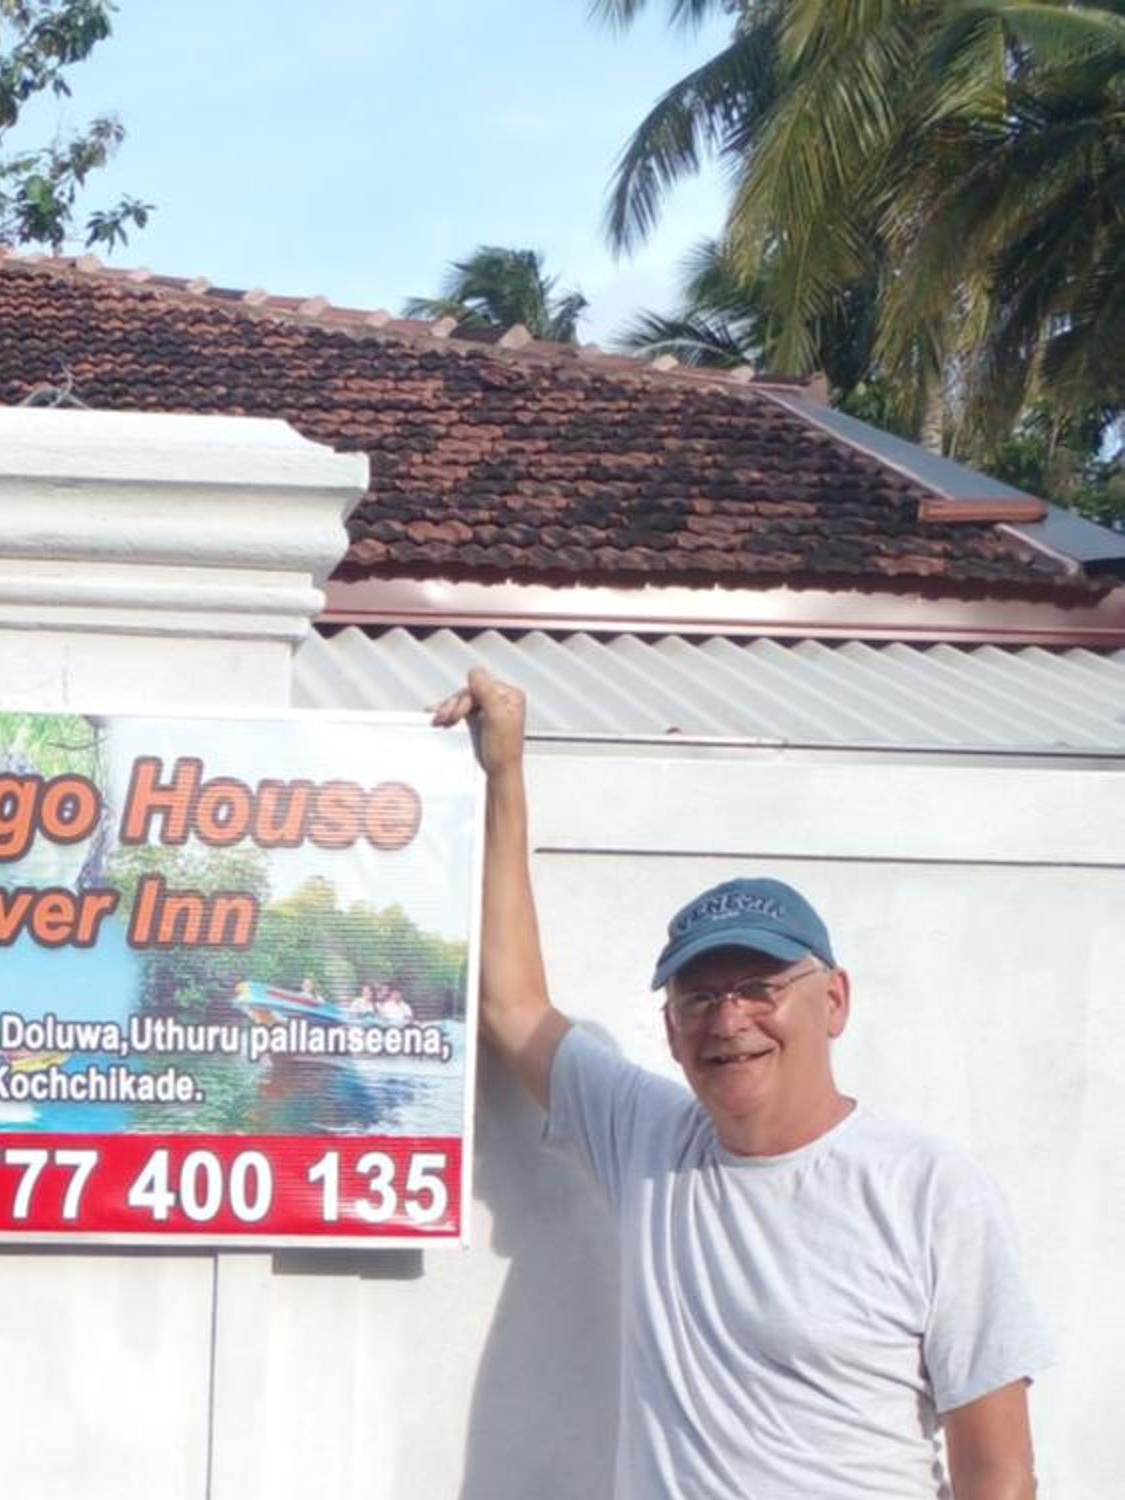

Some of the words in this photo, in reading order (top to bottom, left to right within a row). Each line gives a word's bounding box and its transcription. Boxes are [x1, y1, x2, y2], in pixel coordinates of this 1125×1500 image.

[119, 756, 422, 850] House
[127, 873, 260, 949] Inn
[249, 1019, 453, 1060] pallanseena,
[127, 1149, 274, 1222] 400
[307, 1151, 449, 1224] 135
